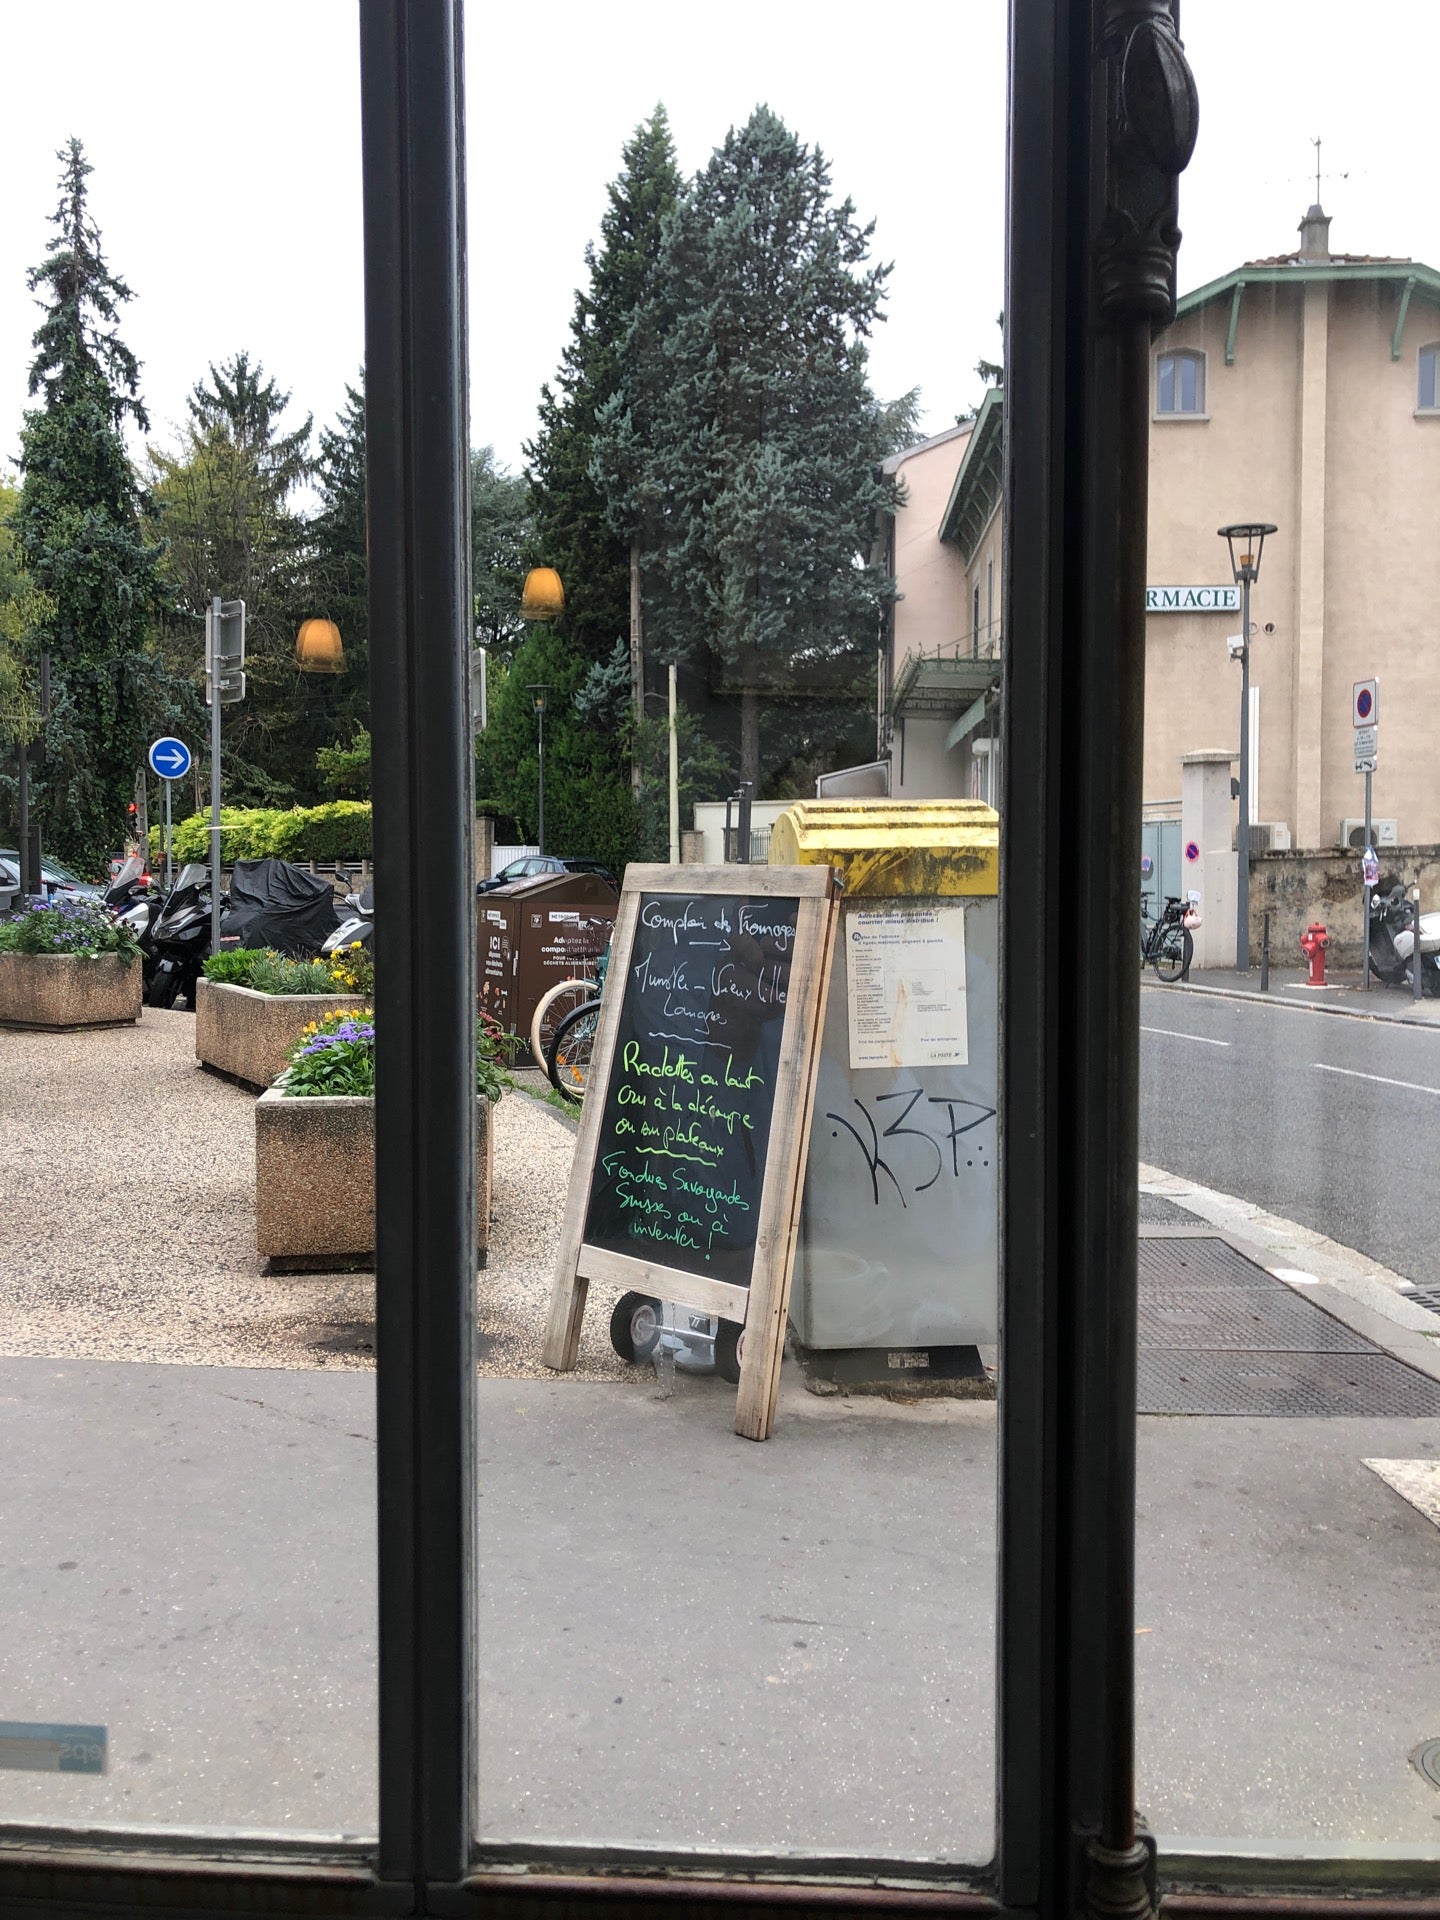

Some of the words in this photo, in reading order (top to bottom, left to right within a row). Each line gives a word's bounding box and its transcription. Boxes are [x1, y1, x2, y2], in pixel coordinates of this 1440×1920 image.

[1146, 589, 1236, 607] RMACIE
[489, 936, 500, 951] ICI
[642, 901, 707, 945] Comptoir
[739, 904, 796, 951] Fromages
[711, 963, 752, 1000] Vieux
[624, 1041, 697, 1085] Raclettes
[725, 1053, 764, 1088] lait
[654, 1087, 667, 1111] à
[671, 1084, 683, 1112] la
[688, 1088, 754, 1135] découpe
[663, 1118, 724, 1157] plateaux
[711, 1214, 729, 1235] à
